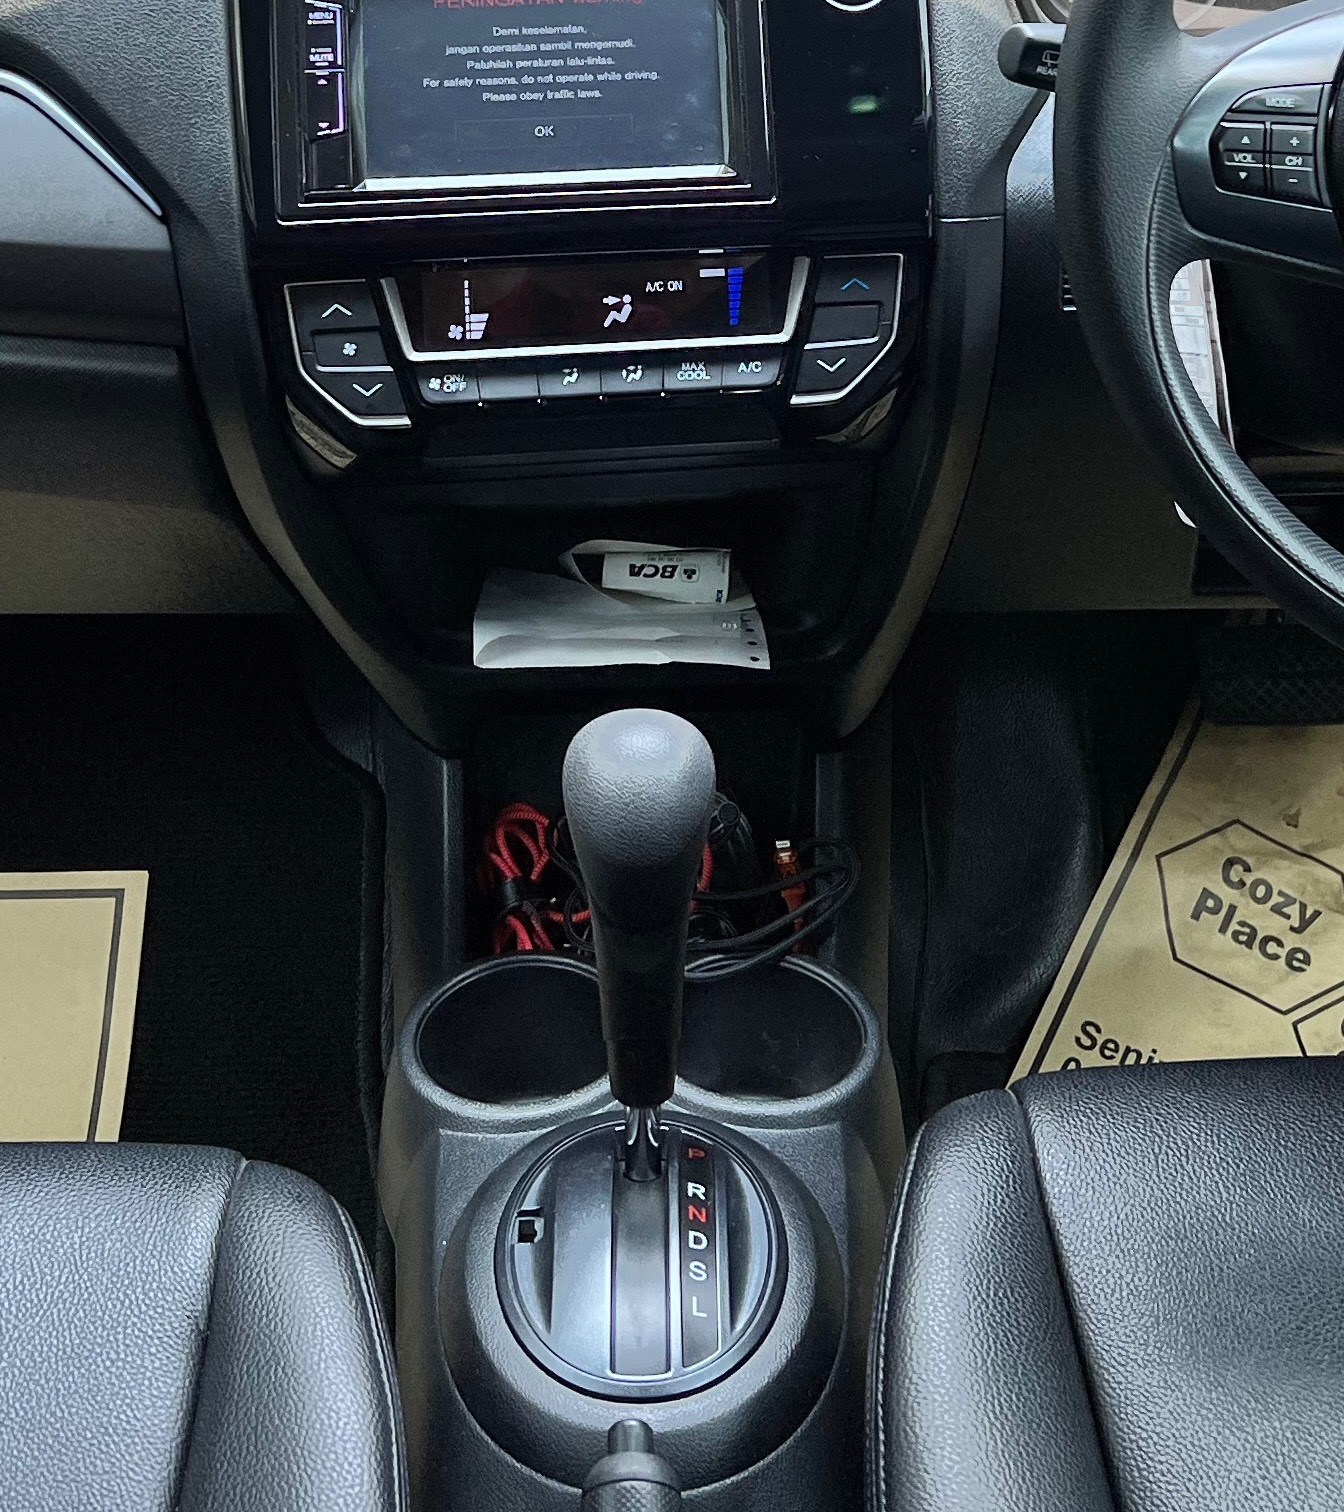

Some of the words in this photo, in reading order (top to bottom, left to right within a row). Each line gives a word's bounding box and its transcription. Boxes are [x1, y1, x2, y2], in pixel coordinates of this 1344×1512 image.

[493, 27, 519, 37] Demi
[540, 41, 571, 51] sambil
[423, 78, 440, 88] For
[444, 77, 473, 88] safety
[521, 74, 535, 84] do
[537, 74, 553, 84] not
[556, 74, 594, 85] operate
[597, 71, 622, 82] while
[483, 92, 517, 102] Please
[520, 91, 544, 102] obey
[546, 90, 574, 100] traffic
[1265, 97, 1295, 108] MODE
[534, 124, 554, 137] OK
[1233, 153, 1256, 163] VOL
[1285, 155, 1303, 165] CH
[645, 281, 664, 292] A/C
[667, 280, 683, 291] ON
[681, 362, 706, 371] MAX
[737, 362, 762, 373] A/C
[677, 370, 711, 381] COOL
[443, 382, 467, 393] OFF
[629, 563, 679, 579] BCA
[1219, 854, 1323, 935] Cozy
[1189, 888, 1313, 975] Place
[687, 1182, 706, 1200] R
[688, 1205, 707, 1223] N
[688, 1231, 708, 1250] D
[688, 1262, 708, 1281] S
[691, 1295, 708, 1318] L
